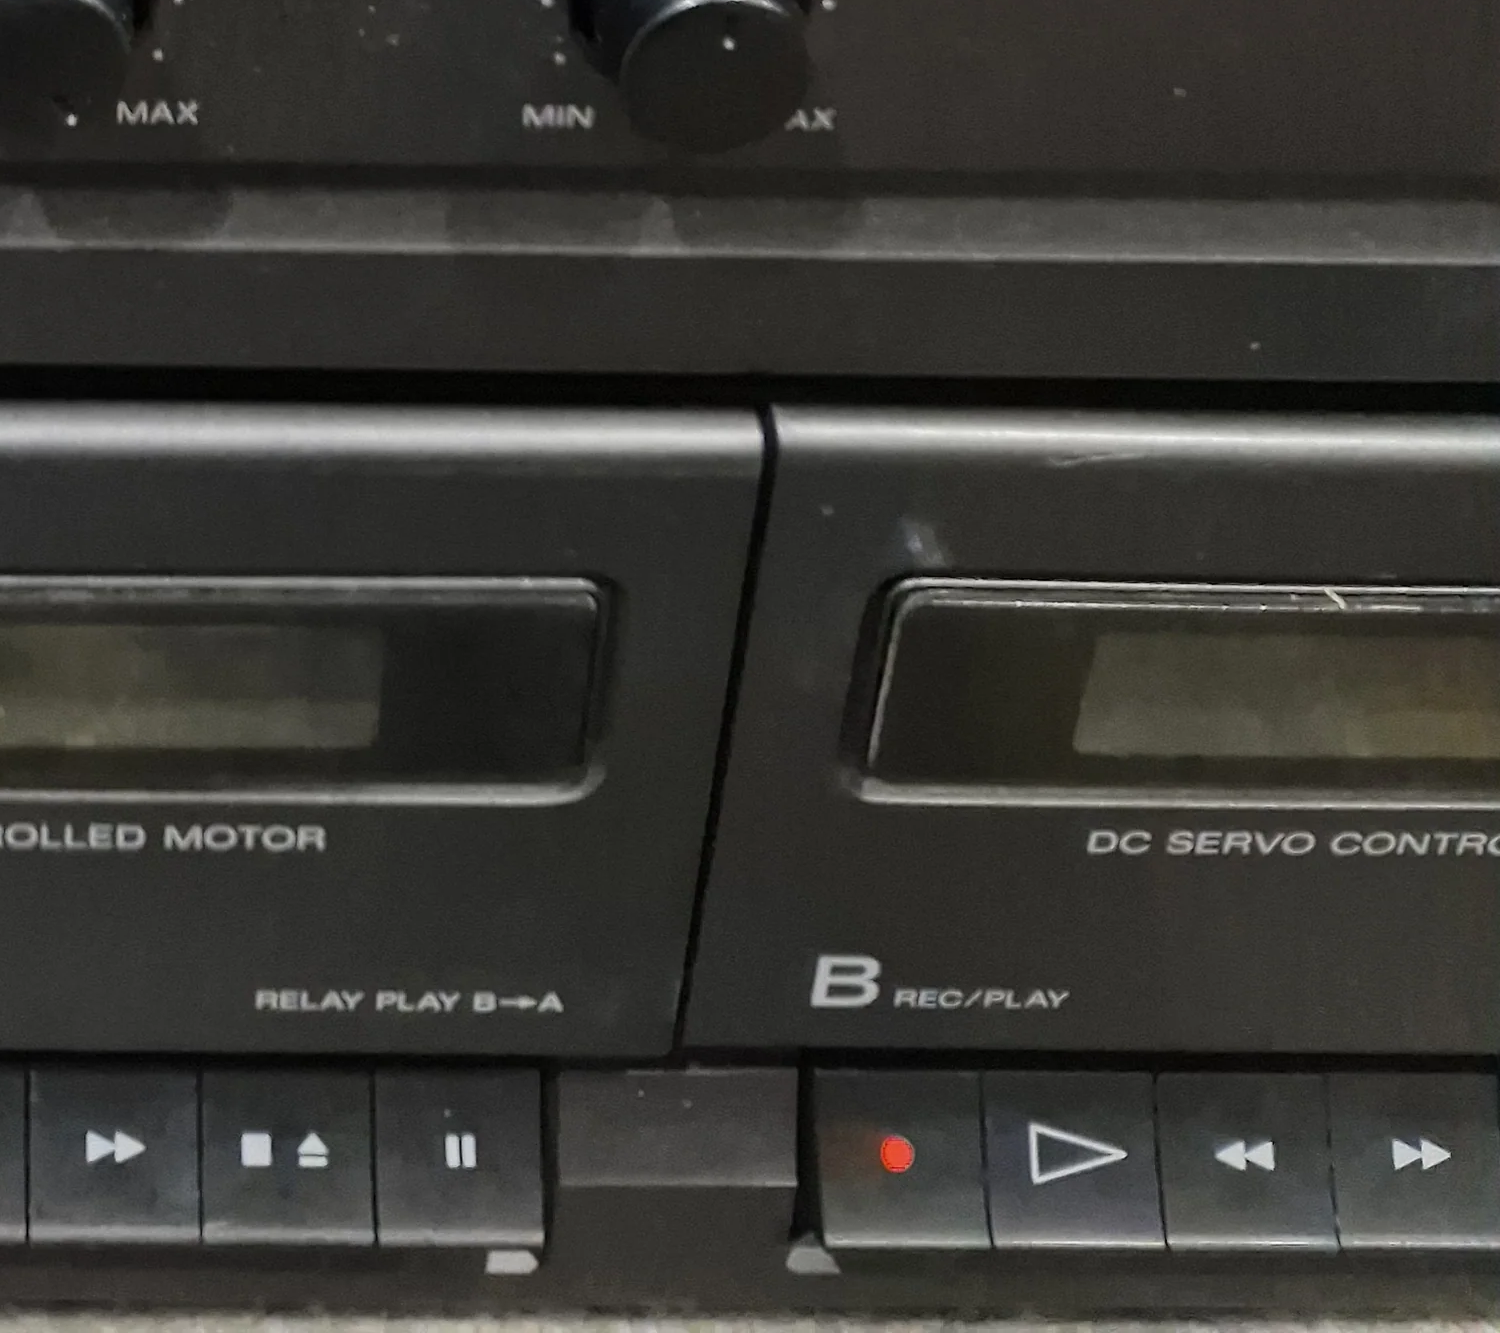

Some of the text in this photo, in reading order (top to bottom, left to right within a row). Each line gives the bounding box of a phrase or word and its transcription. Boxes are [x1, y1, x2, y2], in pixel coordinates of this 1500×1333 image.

[116, 100, 199, 125] MAX
[521, 103, 594, 129] MIN
[784, 107, 837, 131] AX
[163, 824, 327, 852] MOTOR
[1086, 830, 1151, 856] DC
[1165, 831, 1317, 857] SERVO
[810, 954, 882, 1008] B
[254, 989, 365, 1011] RELAY
[375, 990, 461, 1012] PLAY
[894, 988, 1071, 1010] REC/PLAY
